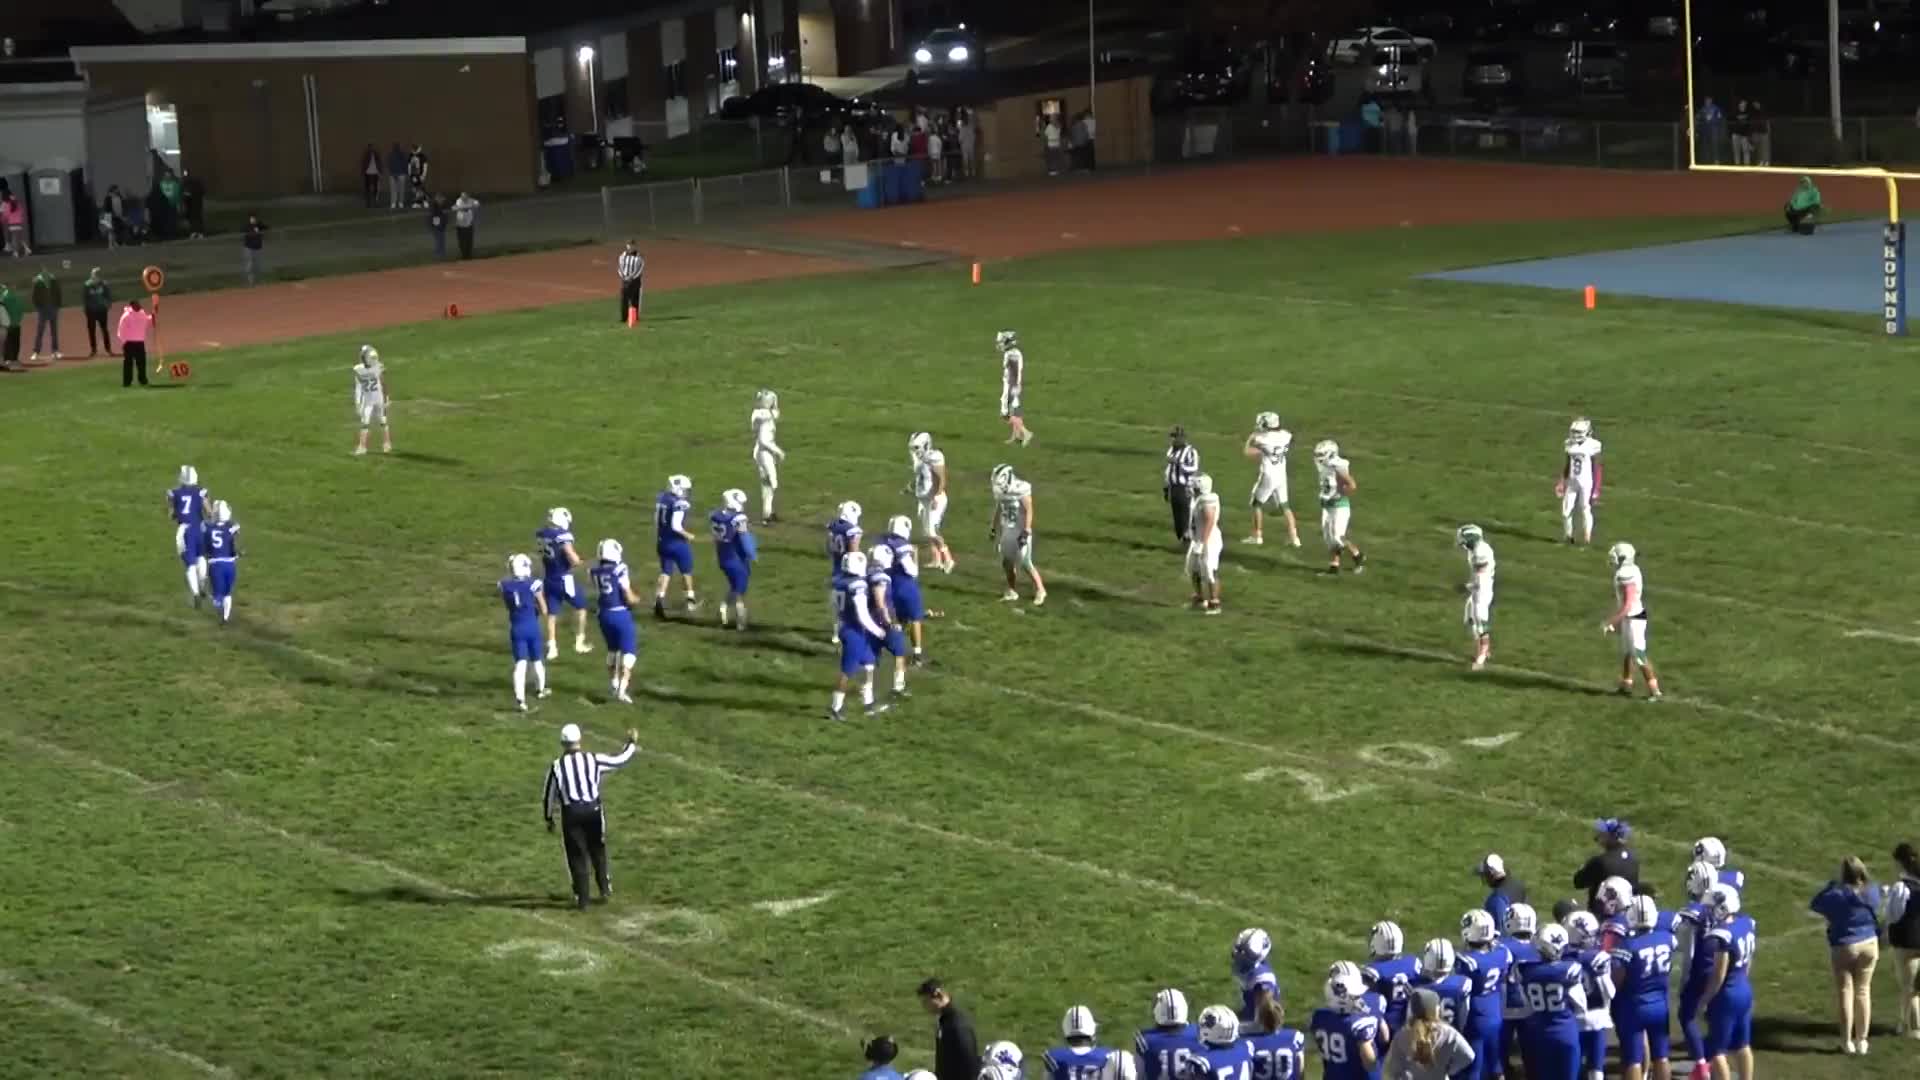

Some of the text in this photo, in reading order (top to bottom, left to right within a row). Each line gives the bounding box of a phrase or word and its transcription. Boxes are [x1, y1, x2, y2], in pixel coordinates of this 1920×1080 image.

[1884, 245, 1897, 334] HOUNDS
[170, 362, 189, 377] 10
[363, 378, 378, 393] 22
[181, 495, 192, 514] 7
[211, 530, 223, 548] 5
[1639, 944, 1672, 978] 72
[1527, 983, 1565, 1012] 82
[1316, 1029, 1347, 1063] 39
[1255, 1048, 1294, 1080] 30
